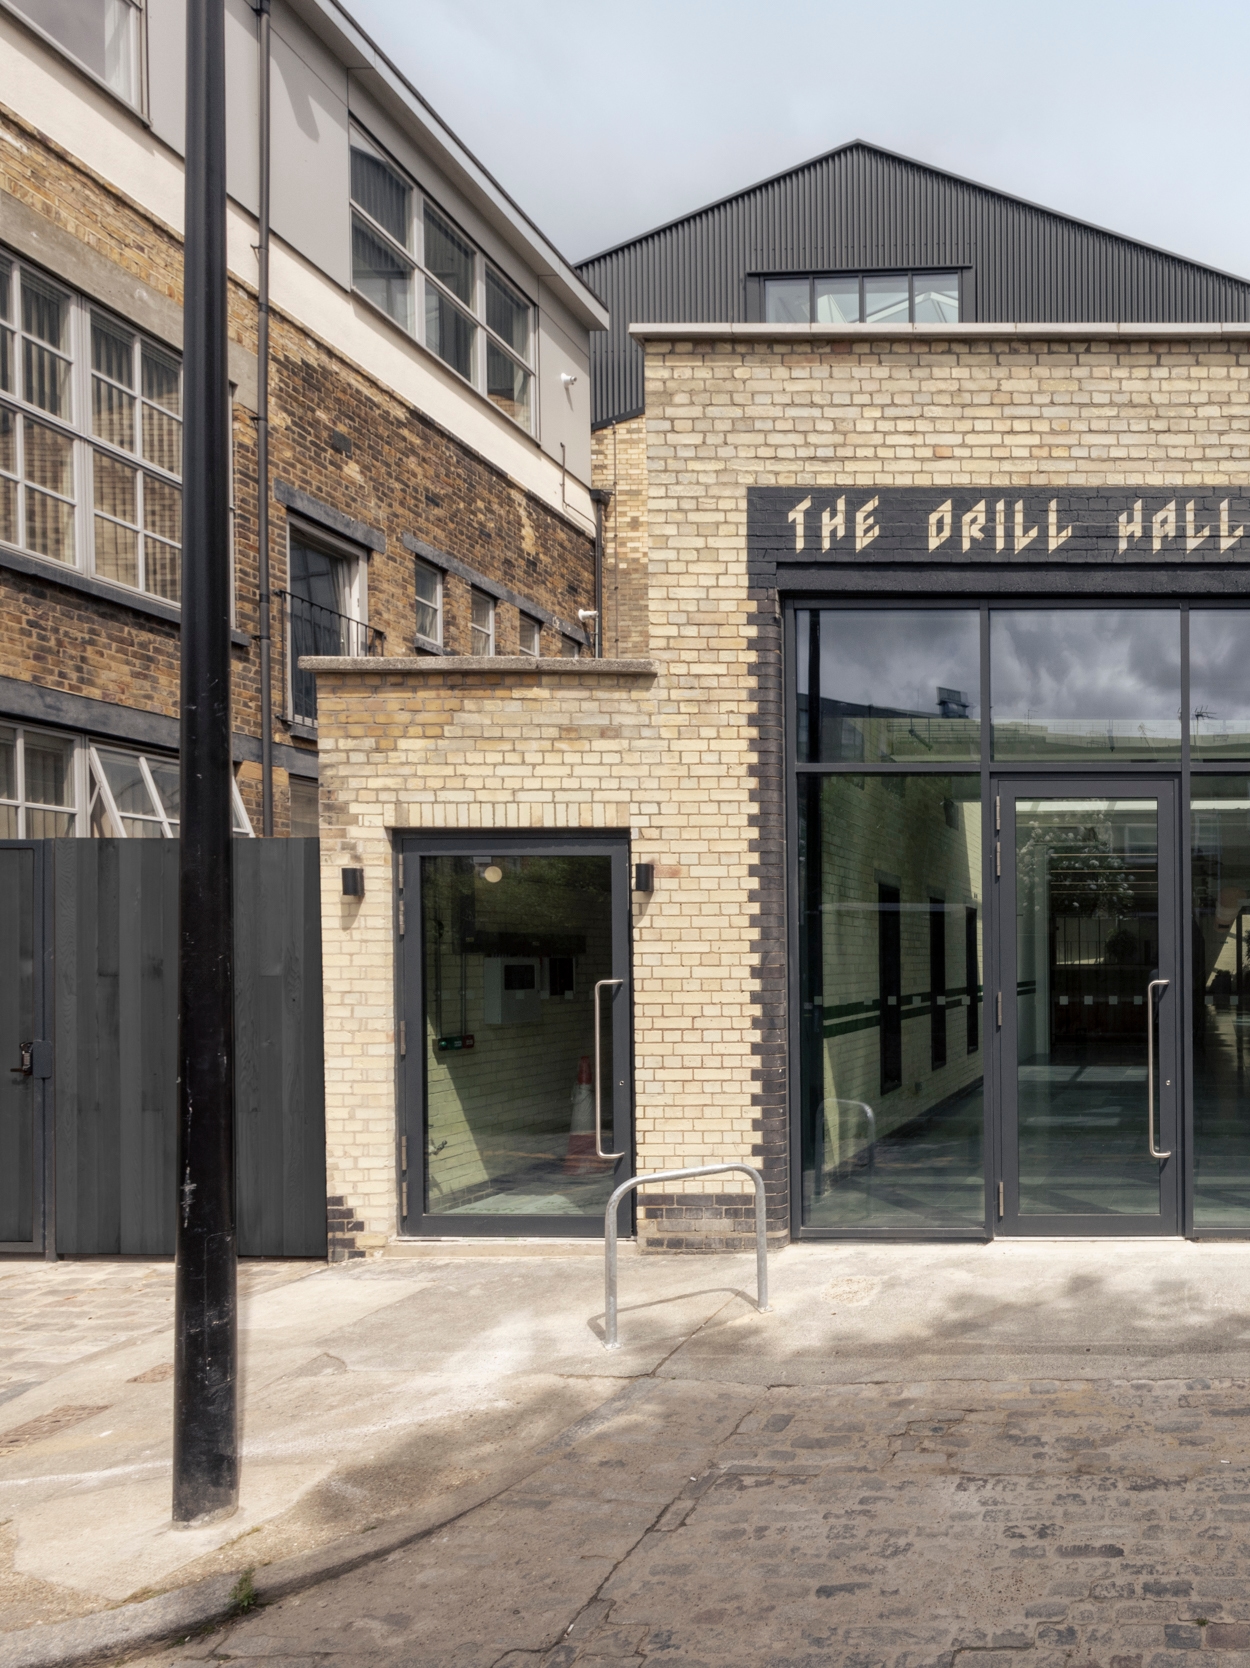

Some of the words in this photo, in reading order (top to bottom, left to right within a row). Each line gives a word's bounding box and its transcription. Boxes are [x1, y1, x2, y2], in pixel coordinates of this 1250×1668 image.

[787, 494, 880, 553] THE
[928, 498, 1072, 554] DRILL
[1118, 498, 1244, 554] HALL
